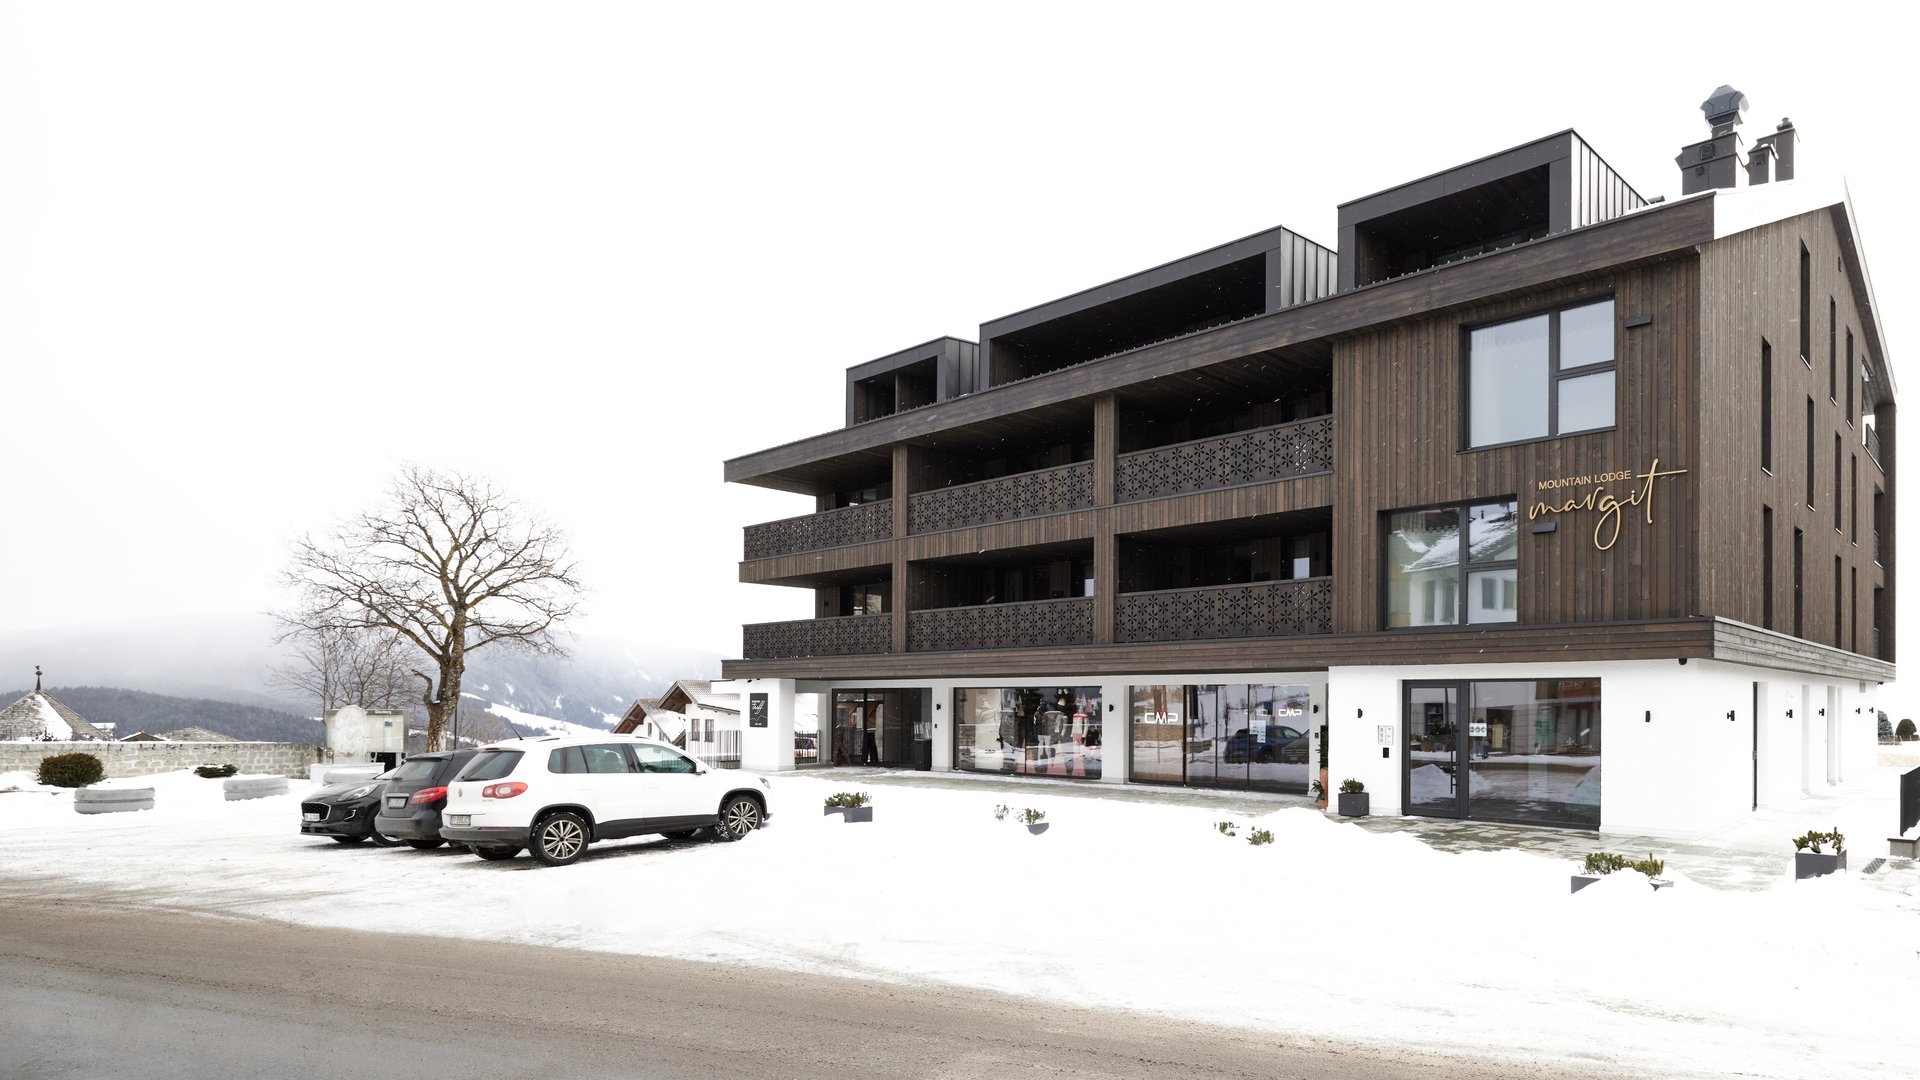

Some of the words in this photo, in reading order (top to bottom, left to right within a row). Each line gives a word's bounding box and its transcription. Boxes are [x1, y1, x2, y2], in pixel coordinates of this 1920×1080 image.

[1538, 475, 1591, 490] MOUNTAIN
[1594, 470, 1632, 483] LODGE
[1529, 458, 1688, 550] margit
[1144, 710, 1179, 725] CMP
[1278, 708, 1303, 717] CMP
